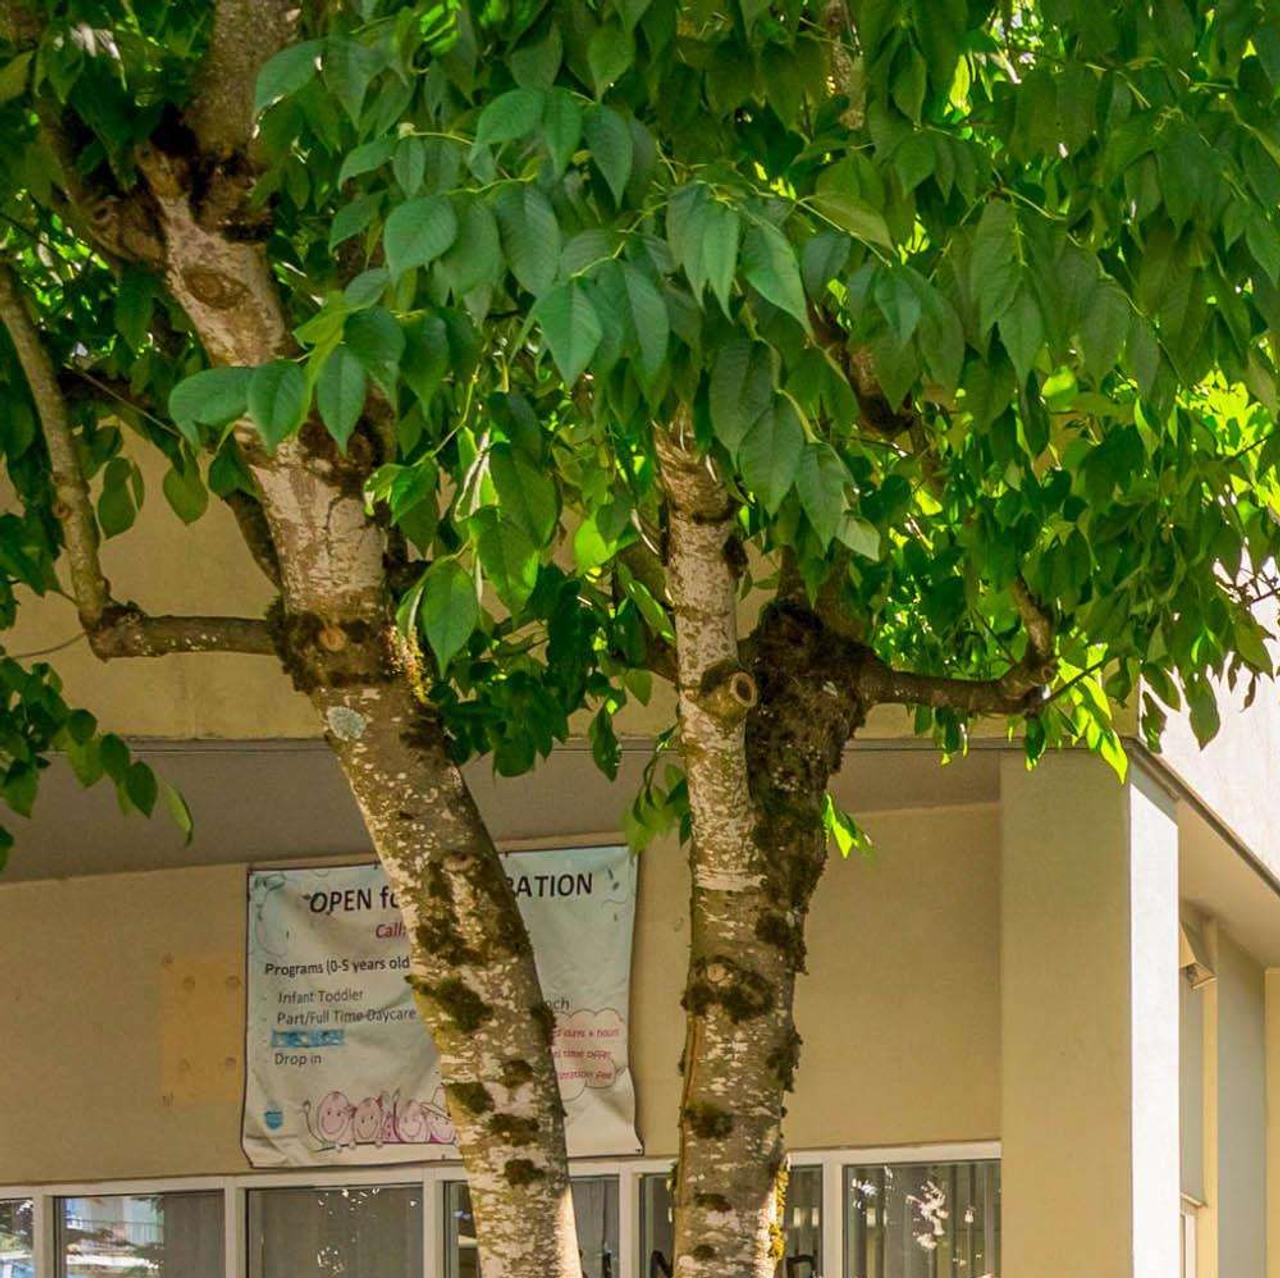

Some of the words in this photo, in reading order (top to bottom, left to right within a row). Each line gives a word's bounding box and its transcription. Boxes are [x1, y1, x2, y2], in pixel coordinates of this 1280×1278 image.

[310, 888, 371, 913] OPEN
[265, 962, 323, 978] Programs
[352, 958, 386, 974] years
[278, 991, 313, 1004] Infant
[318, 988, 363, 1003] Toddler
[277, 1009, 329, 1026] Part/Full
[274, 1052, 307, 1067] Drop
[310, 1053, 322, 1065] in
